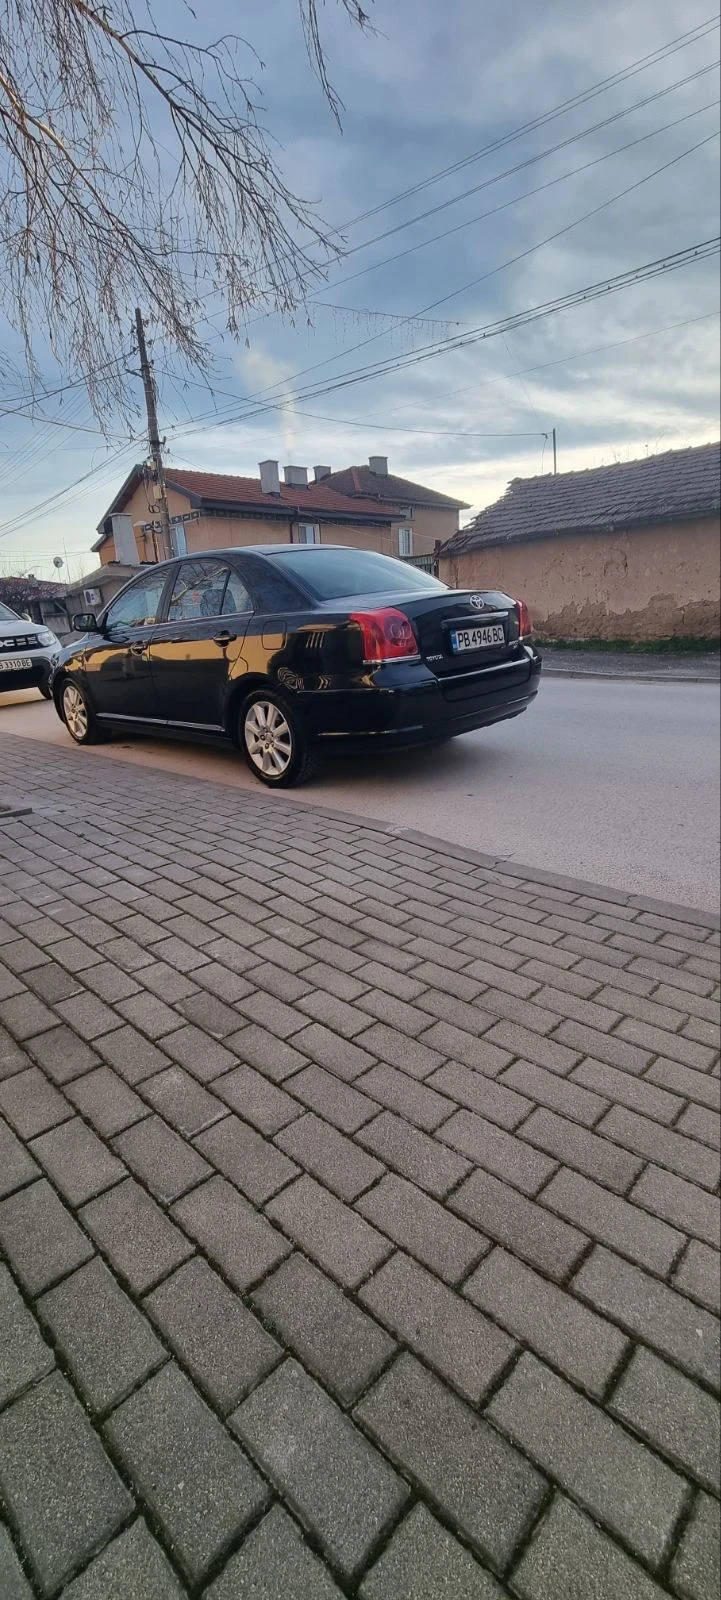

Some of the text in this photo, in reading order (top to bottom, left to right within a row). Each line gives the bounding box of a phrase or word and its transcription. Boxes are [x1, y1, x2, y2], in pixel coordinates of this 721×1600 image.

[457, 632, 470, 648] PB
[472, 629, 492, 645] 4946
[493, 627, 503, 642] BC
[5, 660, 21, 668] 3310
